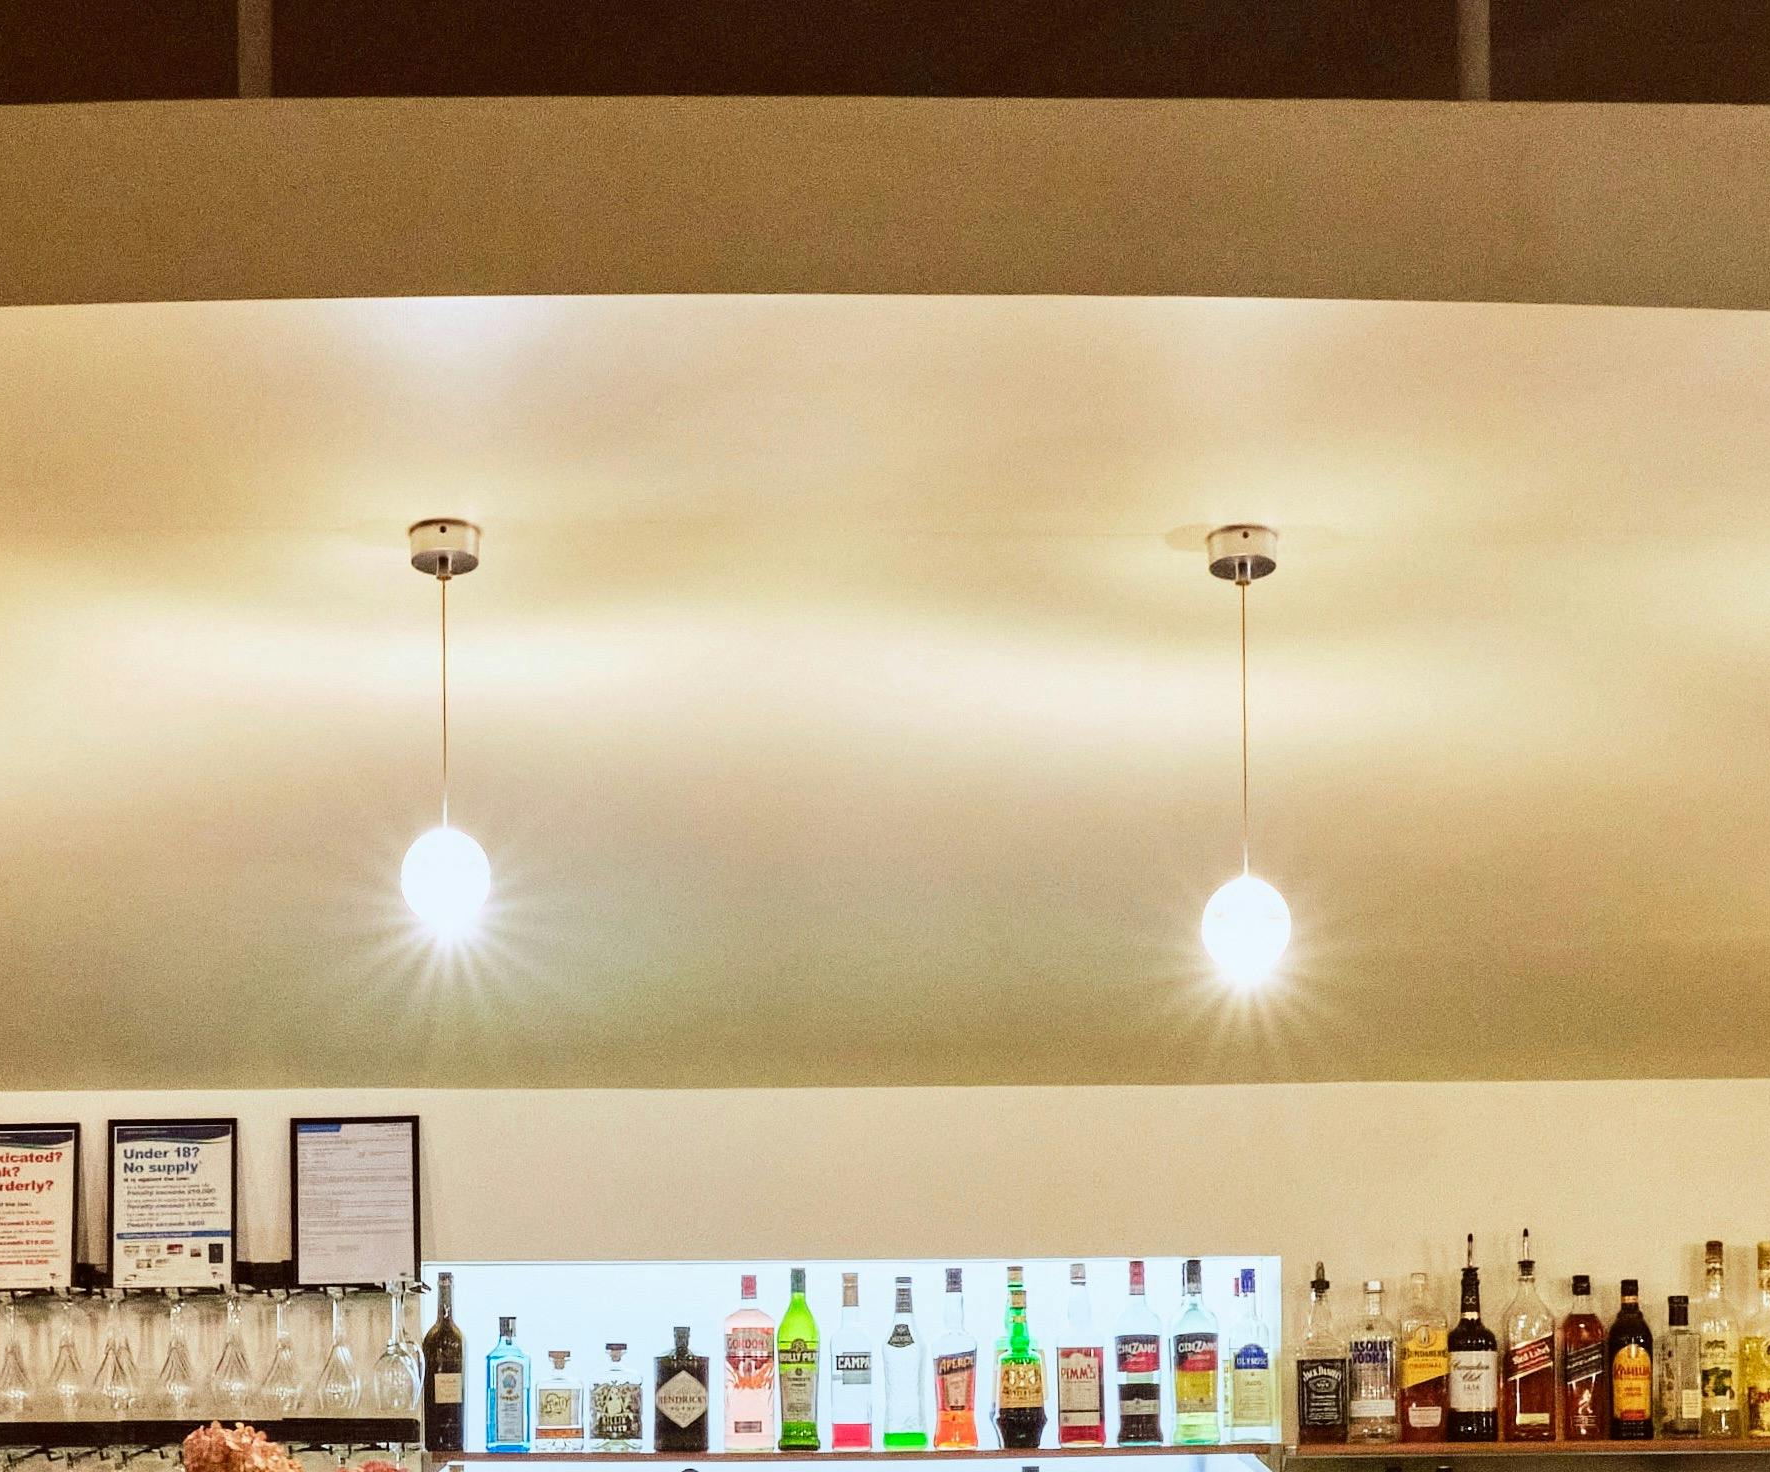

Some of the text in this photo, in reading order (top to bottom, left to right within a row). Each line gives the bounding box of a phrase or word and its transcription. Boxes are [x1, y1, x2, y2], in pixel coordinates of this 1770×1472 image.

[123, 1146, 200, 1160] Under 18?
[123, 1161, 199, 1175] No supply
[1117, 1341, 1157, 1355] CINZANO
[1178, 1339, 1218, 1354] CINZANO
[1061, 1364, 1096, 1380] PIMM'S
